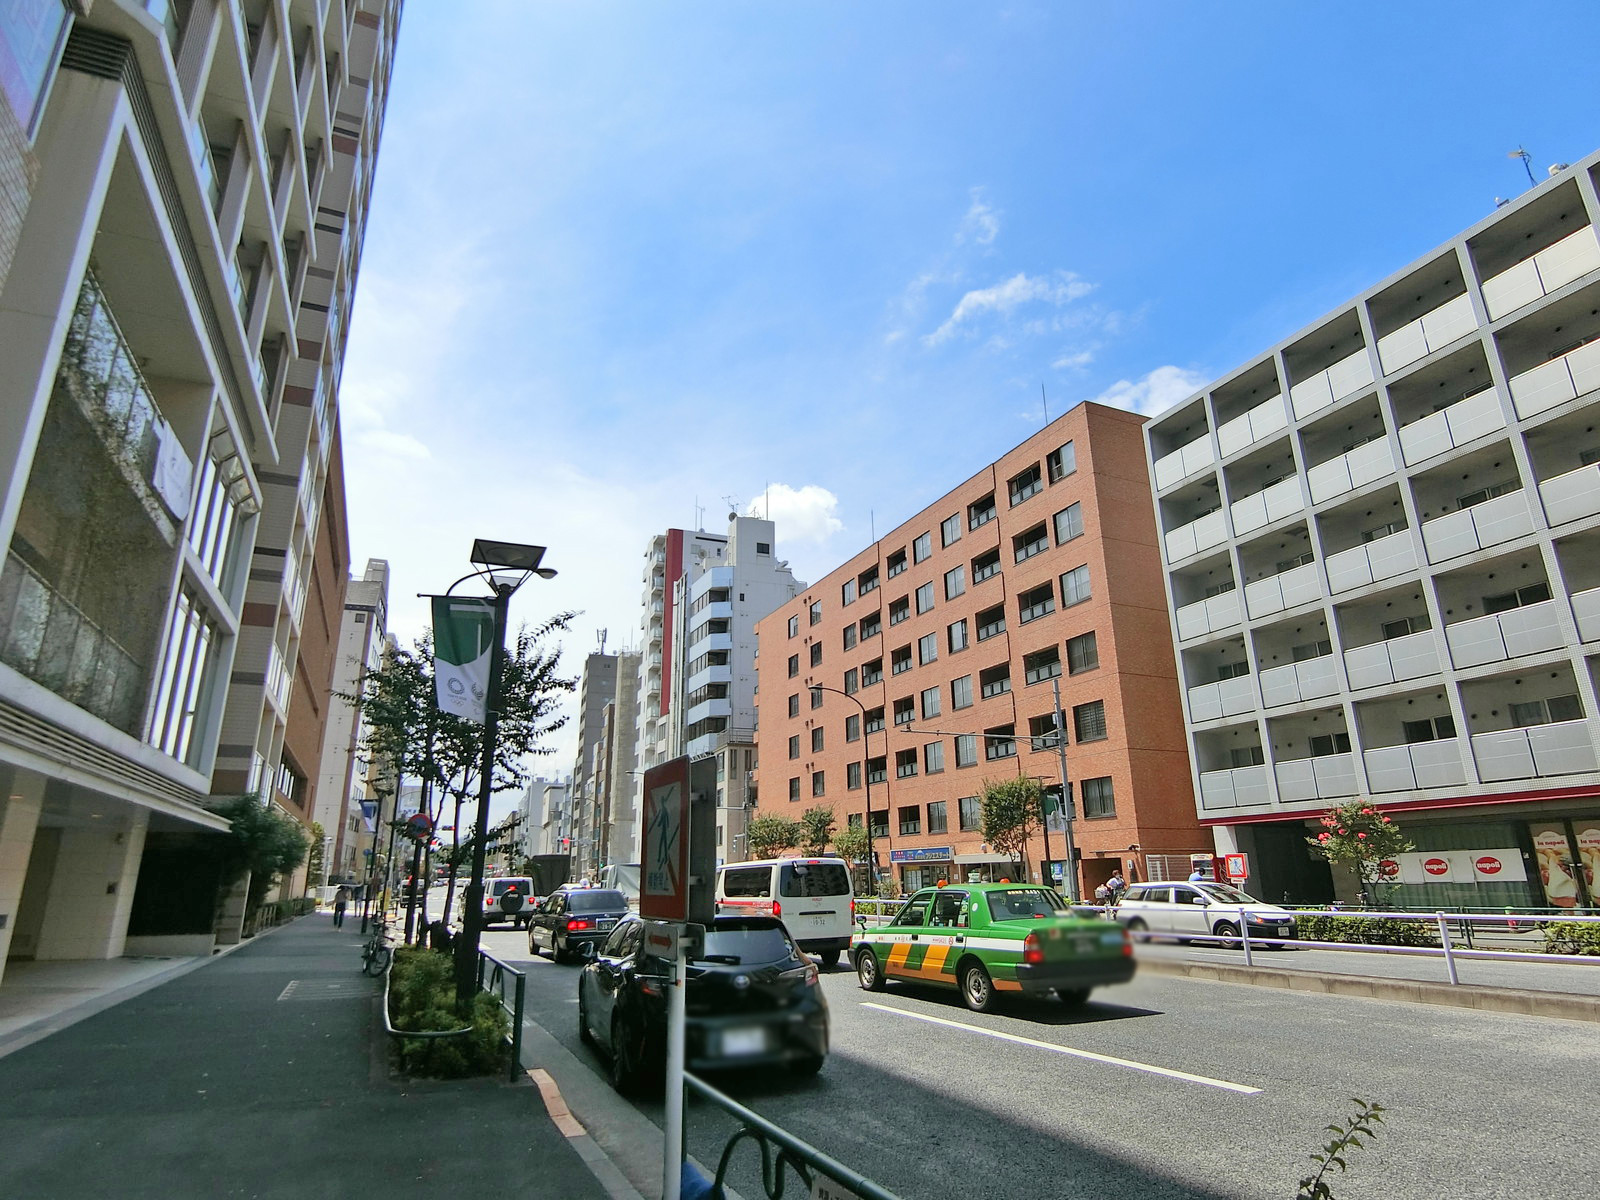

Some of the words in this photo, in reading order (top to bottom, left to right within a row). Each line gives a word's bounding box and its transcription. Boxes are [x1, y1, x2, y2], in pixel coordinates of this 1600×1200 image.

[1545, 839, 1566, 847] napoli
[1425, 863, 1447, 871] napoli
[1476, 861, 1501, 871] napoli
